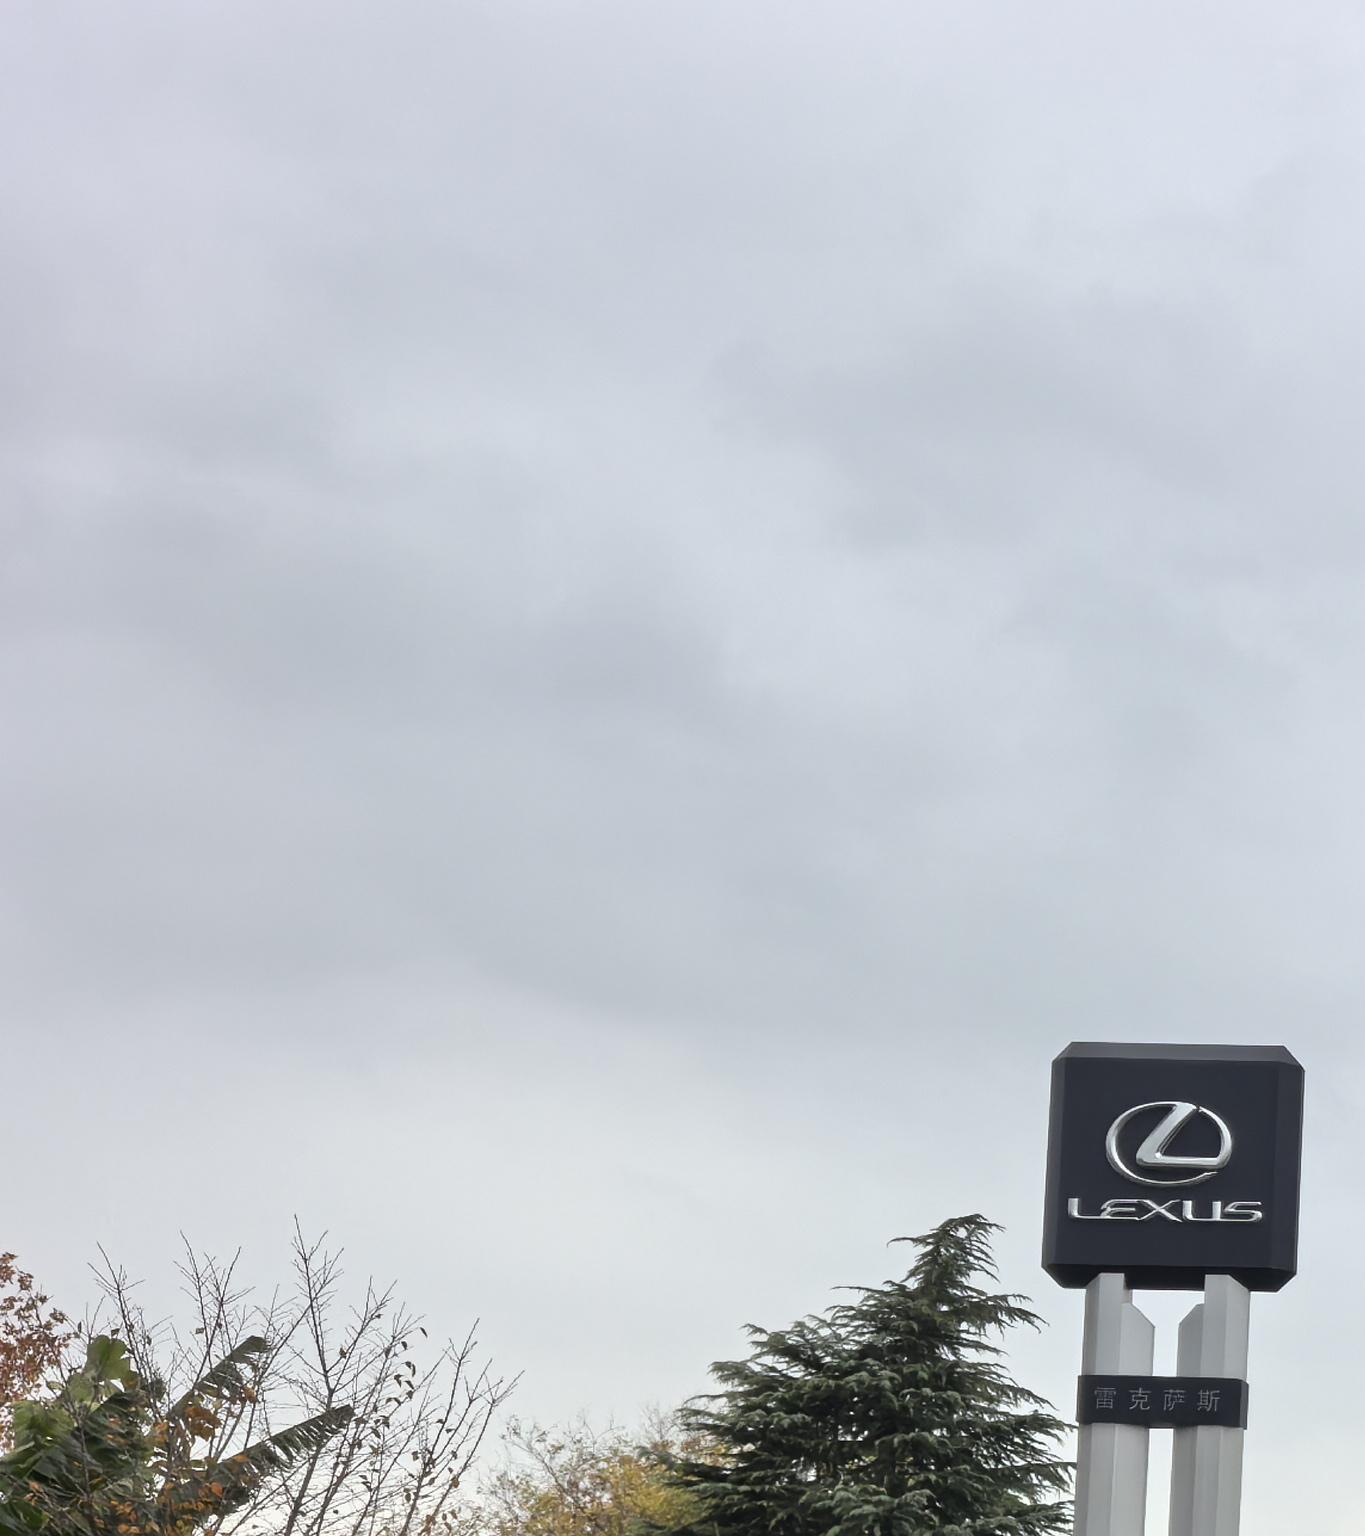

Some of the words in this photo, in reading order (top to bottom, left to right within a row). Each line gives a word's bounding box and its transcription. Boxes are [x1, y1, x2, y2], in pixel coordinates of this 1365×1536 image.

[1067, 1197, 1263, 1223] LEXUS
[1094, 1387, 1222, 1412] 雷克萨斯
